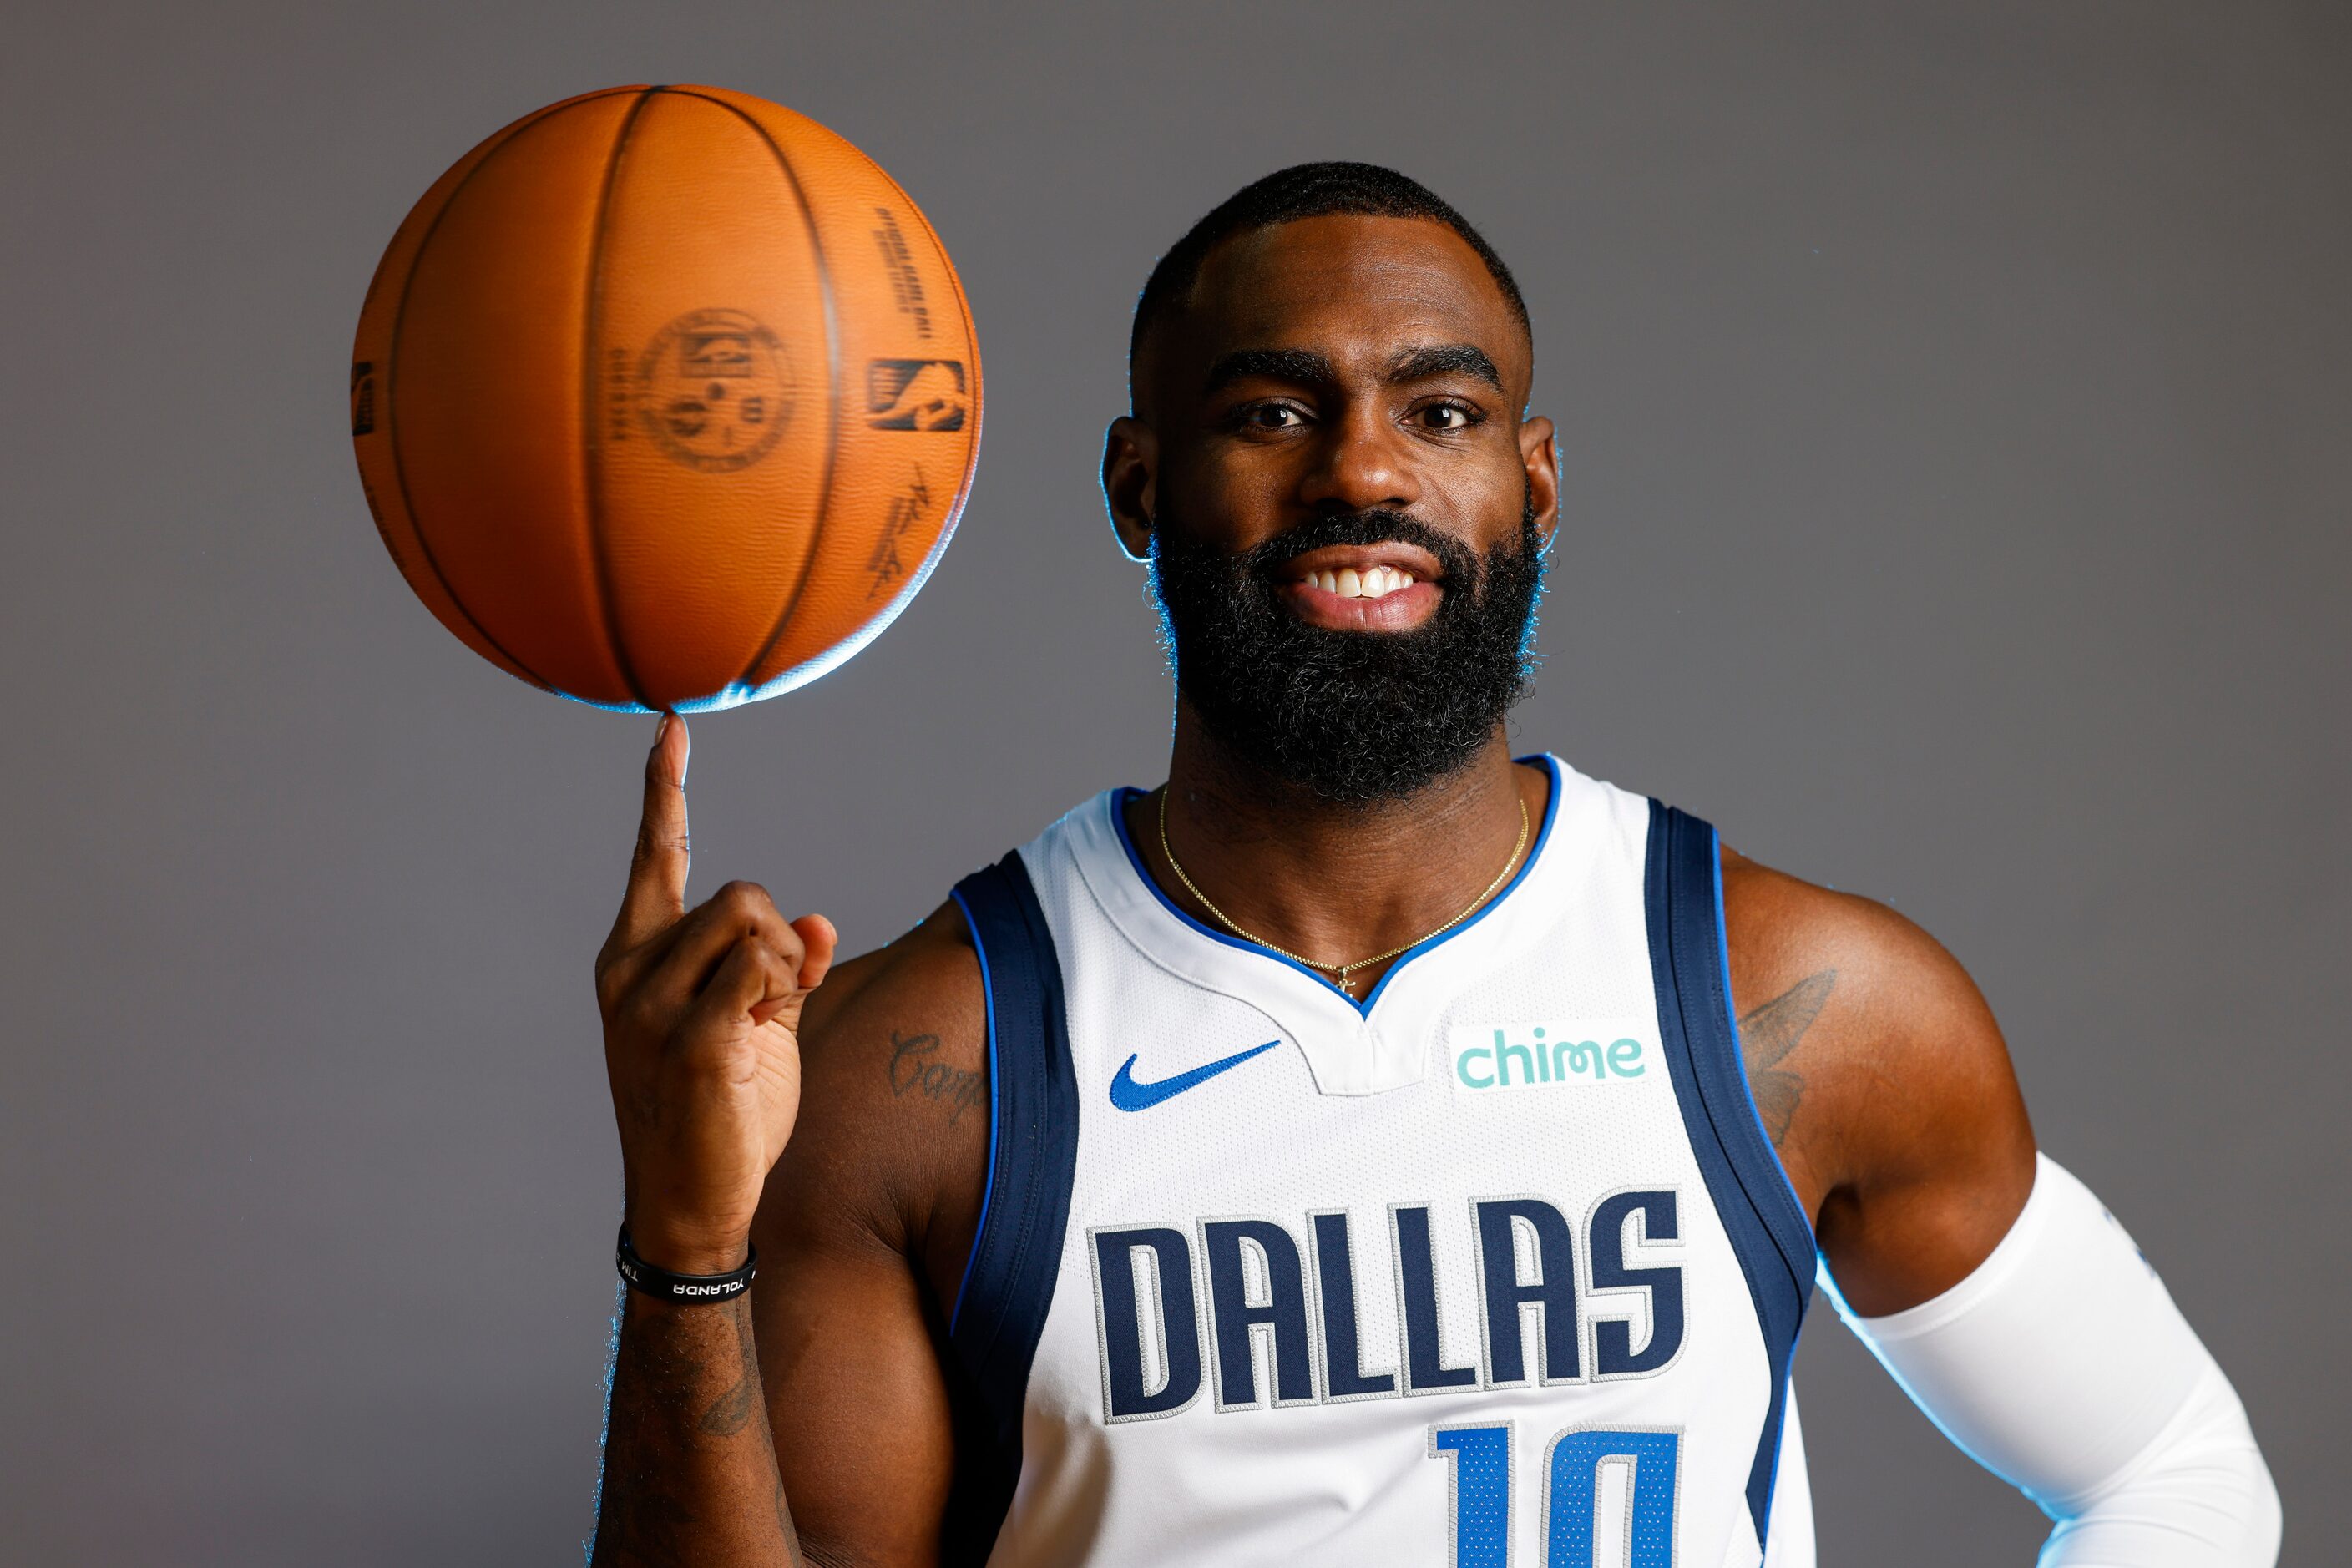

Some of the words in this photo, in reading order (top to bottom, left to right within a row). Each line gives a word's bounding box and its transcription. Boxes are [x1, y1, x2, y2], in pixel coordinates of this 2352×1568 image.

[1457, 1027, 1646, 1089] chime
[621, 1262, 639, 1282] TIM
[673, 1277, 744, 1296] YOLANDA
[1086, 1183, 1690, 1425] DALLAS
